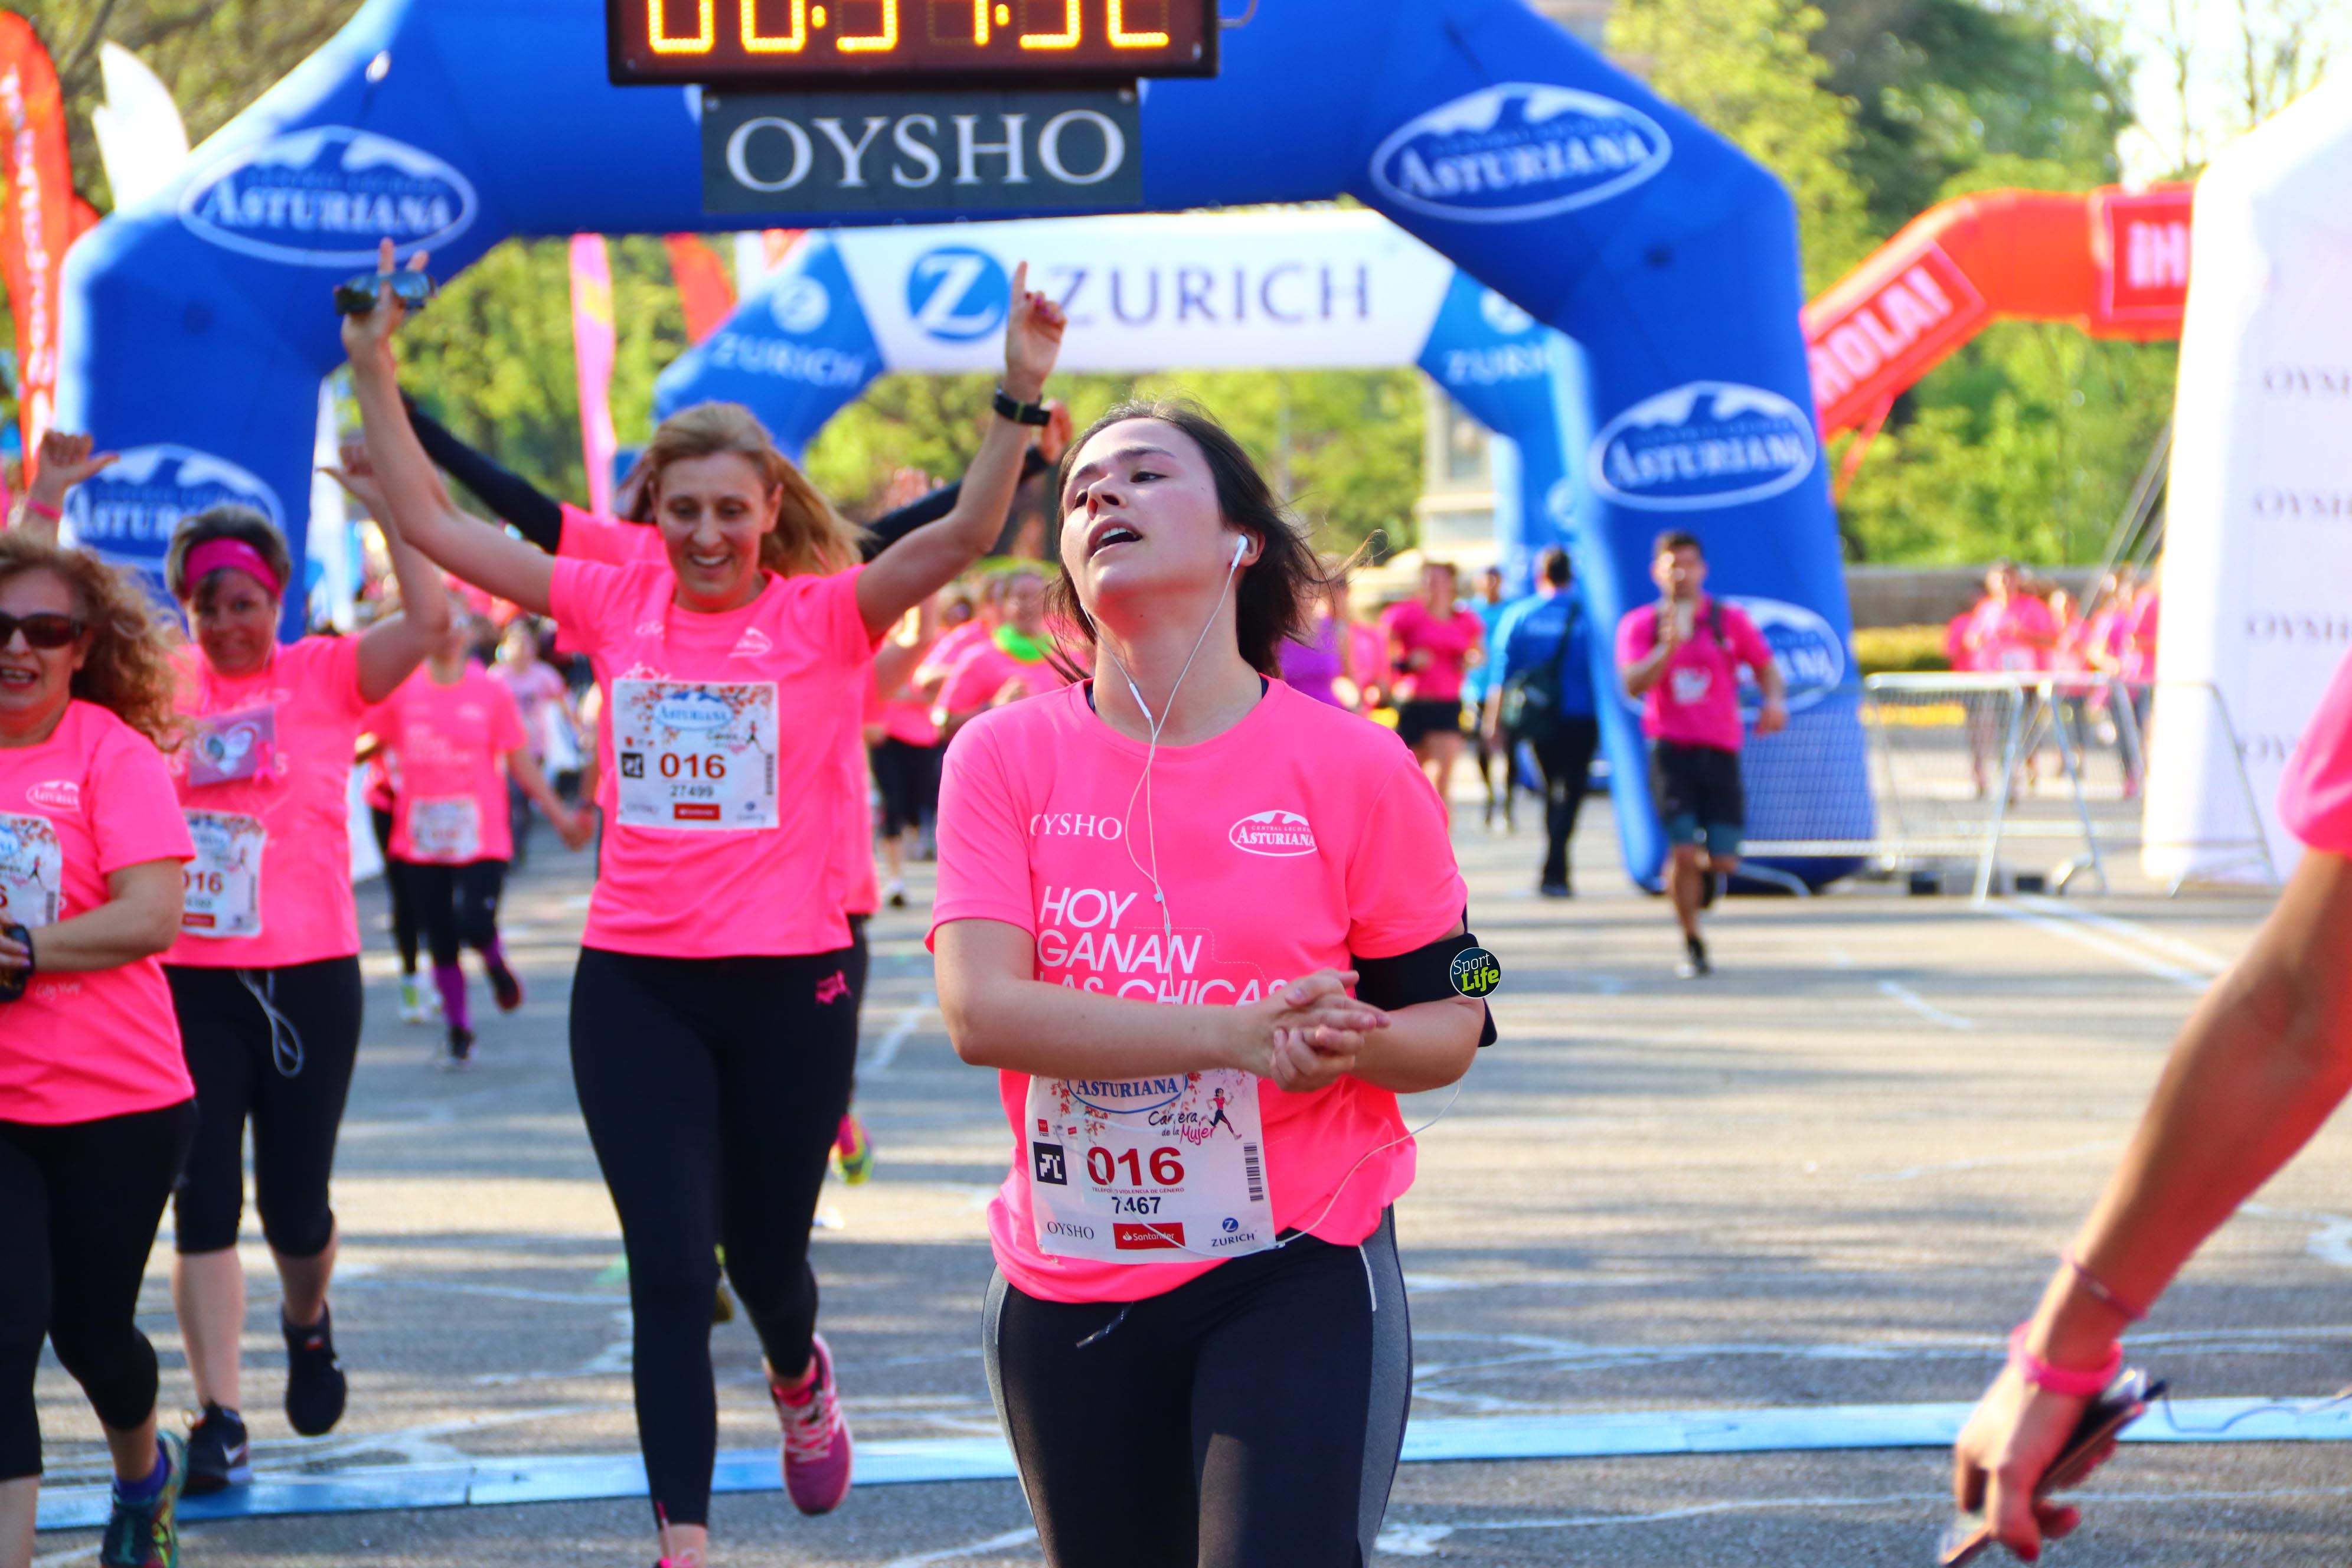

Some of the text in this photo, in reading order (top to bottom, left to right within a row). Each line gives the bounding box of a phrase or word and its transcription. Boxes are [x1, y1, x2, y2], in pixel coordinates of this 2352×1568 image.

[726, 110, 1126, 192] OYSHO
[1399, 132, 1653, 197] ASTURIANA
[200, 174, 453, 236] ASTURIANA
[1050, 264, 1371, 325] ZURICH
[659, 752, 726, 779] 016
[1236, 825, 1315, 847] ASTURIANA
[1039, 886, 1138, 929] HOY
[1037, 930, 1201, 974] GANAN
[1076, 1077, 1178, 1097] ASTURIANA
[1162, 1122, 1217, 1145] de la Mujer
[1087, 1146, 1184, 1186] 016
[1112, 1196, 1161, 1214] 7467
[1047, 1221, 1094, 1240] OYSHO
[1211, 1234, 1255, 1247] ZURICH
